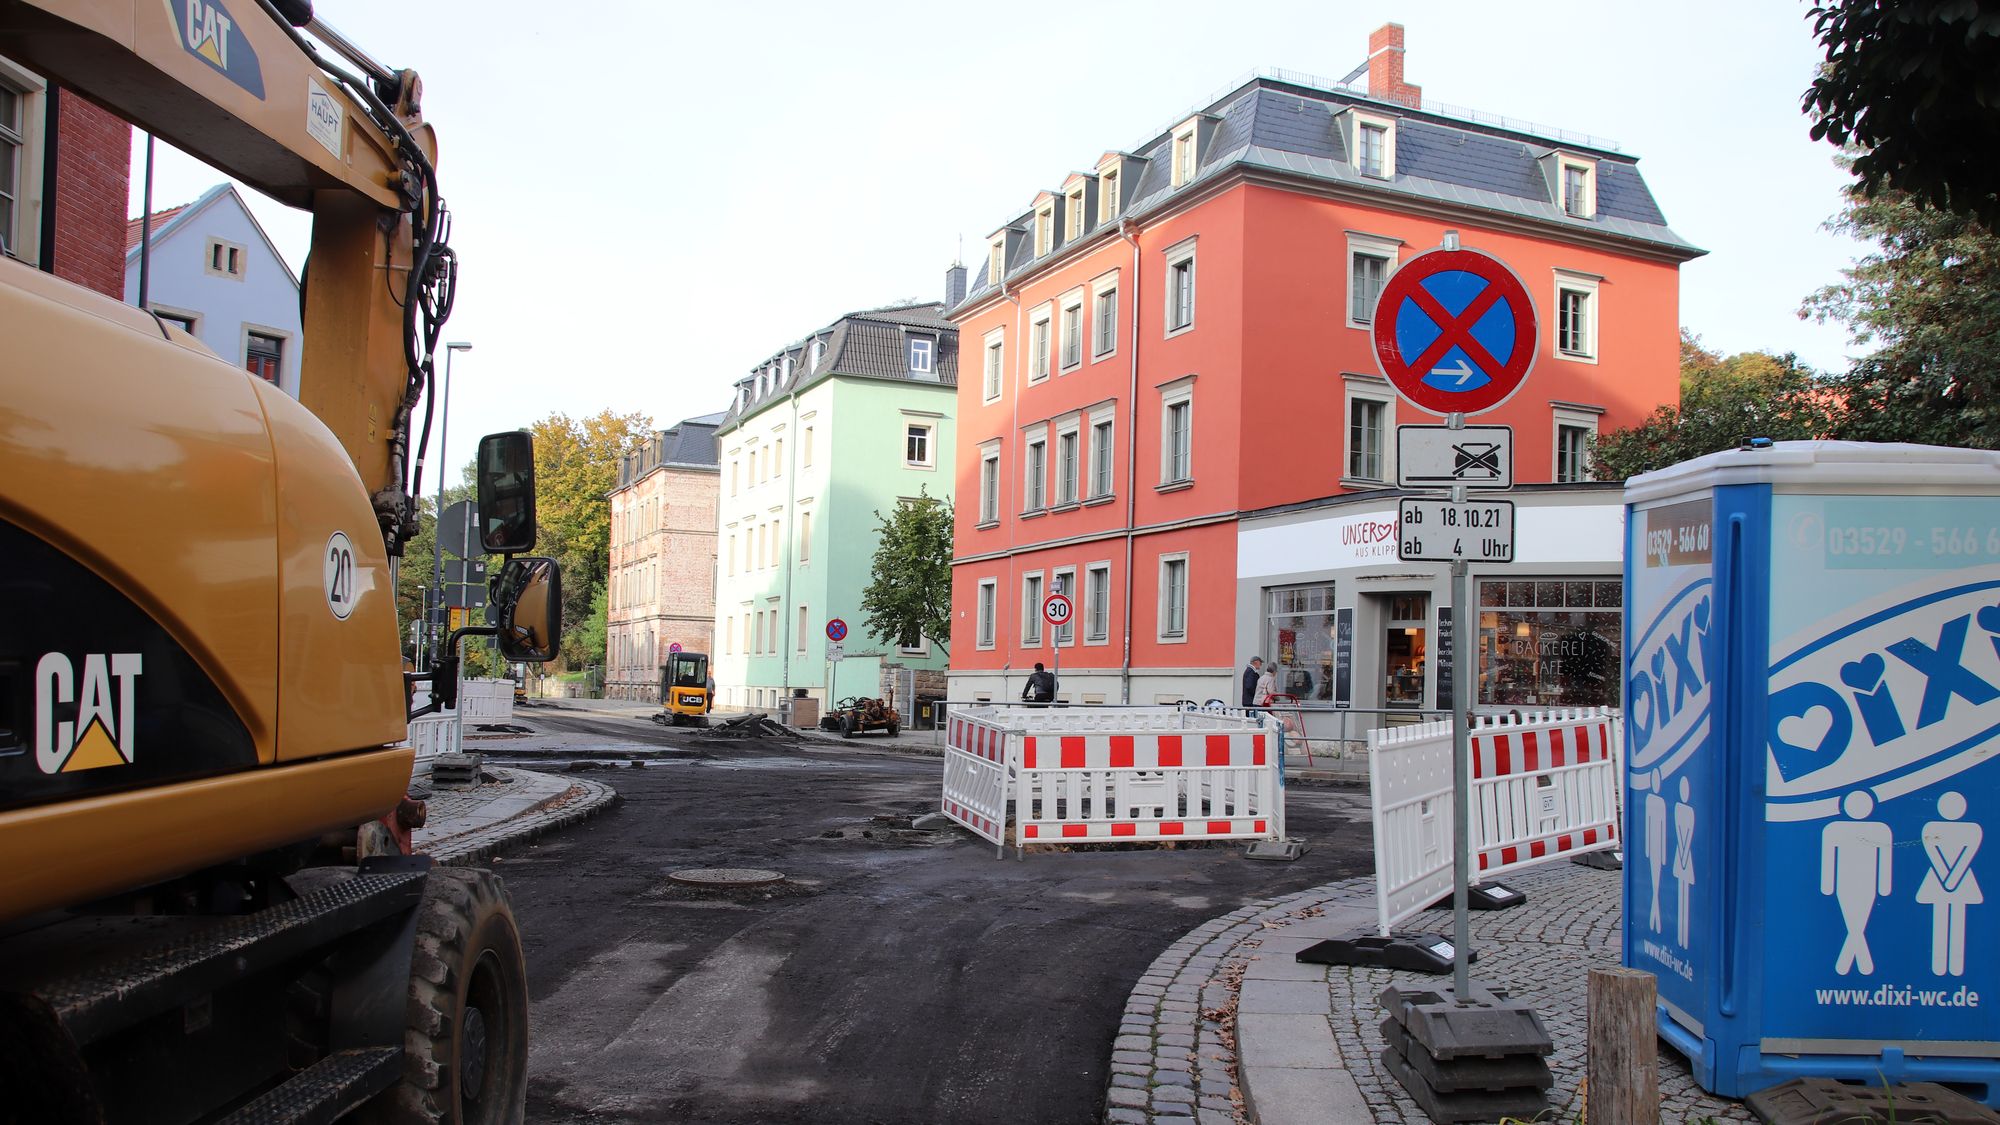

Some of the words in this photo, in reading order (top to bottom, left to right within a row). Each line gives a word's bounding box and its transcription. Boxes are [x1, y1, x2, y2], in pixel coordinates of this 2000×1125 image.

[187, 0, 231, 71] CAT
[311, 98, 338, 133] HAUPT
[1405, 505, 1423, 524] ab
[1355, 547, 1369, 558] AUS
[1404, 537, 1422, 555] ab
[1453, 538, 1463, 556] 4
[1483, 538, 1509, 557] Uhr
[1648, 528, 1672, 556] 03529
[1679, 526, 1696, 552] 566
[1697, 523, 1709, 551] 60
[1829, 527, 1907, 555] 03529
[1931, 527, 1979, 555] 566
[331, 547, 351, 604] 20
[1049, 603, 1066, 617] 30
[36, 652, 143, 775] CAT
[1643, 938, 1693, 982] www.dixi-wc.de
[1815, 984, 1979, 1007] www.dixi-wc.de
